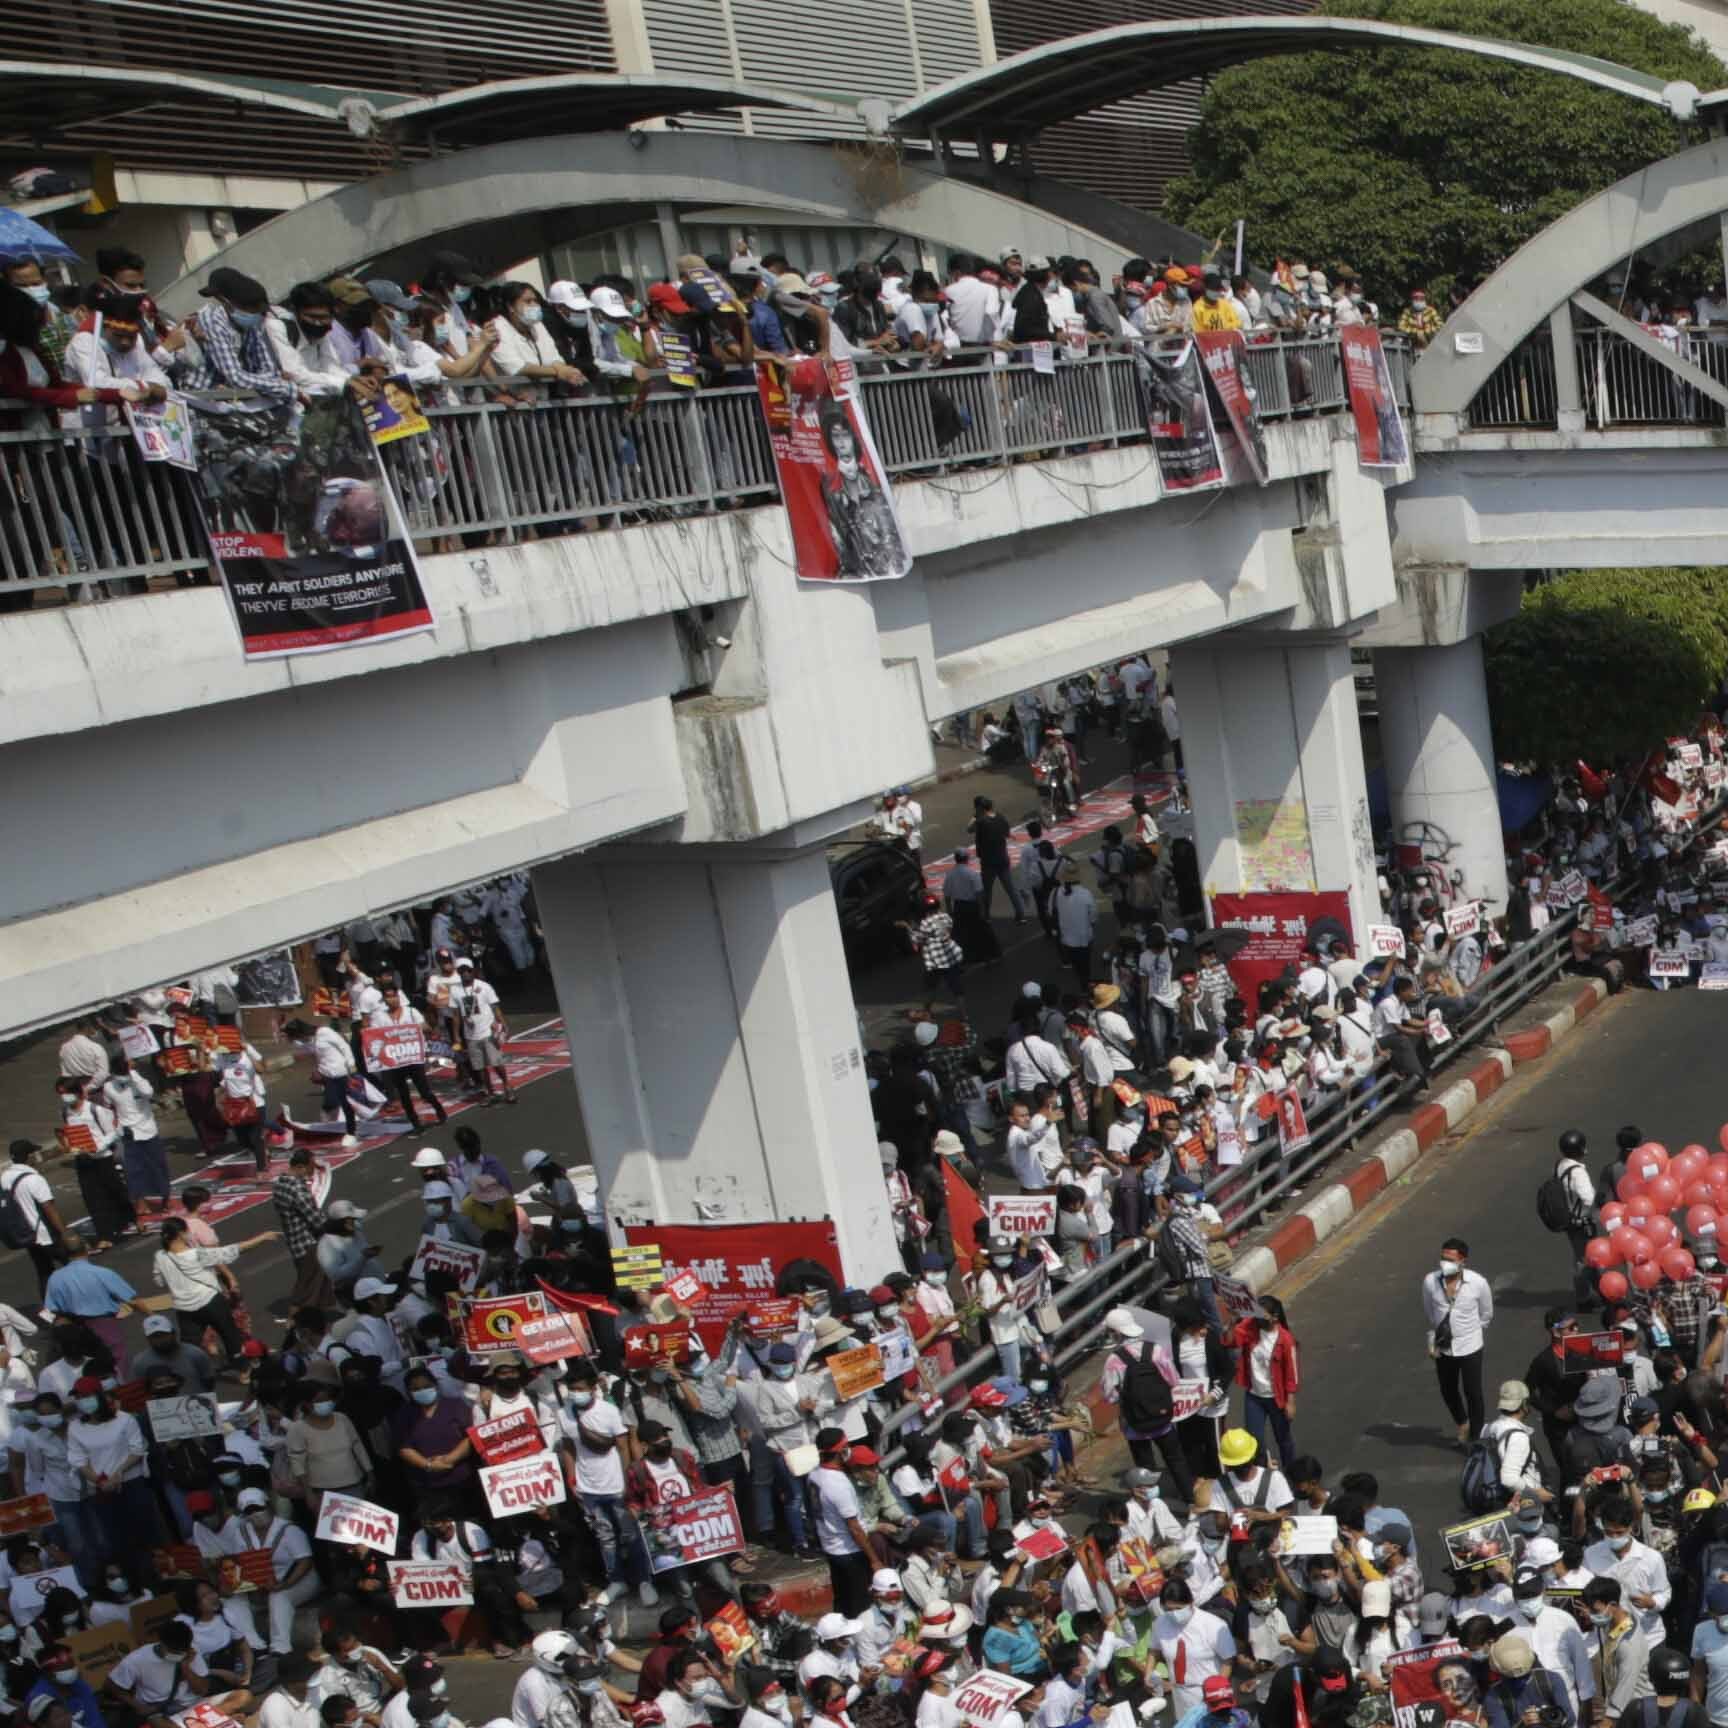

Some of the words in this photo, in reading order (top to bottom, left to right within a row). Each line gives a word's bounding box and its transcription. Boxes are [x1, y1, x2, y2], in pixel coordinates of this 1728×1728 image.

[234, 583, 265, 596] THEY
[1656, 960, 1683, 971] CDM
[384, 1040, 420, 1056] CDM
[1000, 1215, 1048, 1232] CDM
[477, 1421, 503, 1438] GET
[502, 1412, 527, 1430] OUT
[502, 1478, 556, 1508] CDM
[331, 1515, 387, 1545] CDM
[679, 1514, 735, 1547] CDM
[406, 1580, 460, 1600] CDM
[1391, 1654, 1408, 1667] WE
[1408, 1648, 1434, 1664] WANT
[1434, 1643, 1455, 1657] OUR
[954, 1689, 1001, 1722] CDM
[1418, 1708, 1434, 1722] W
